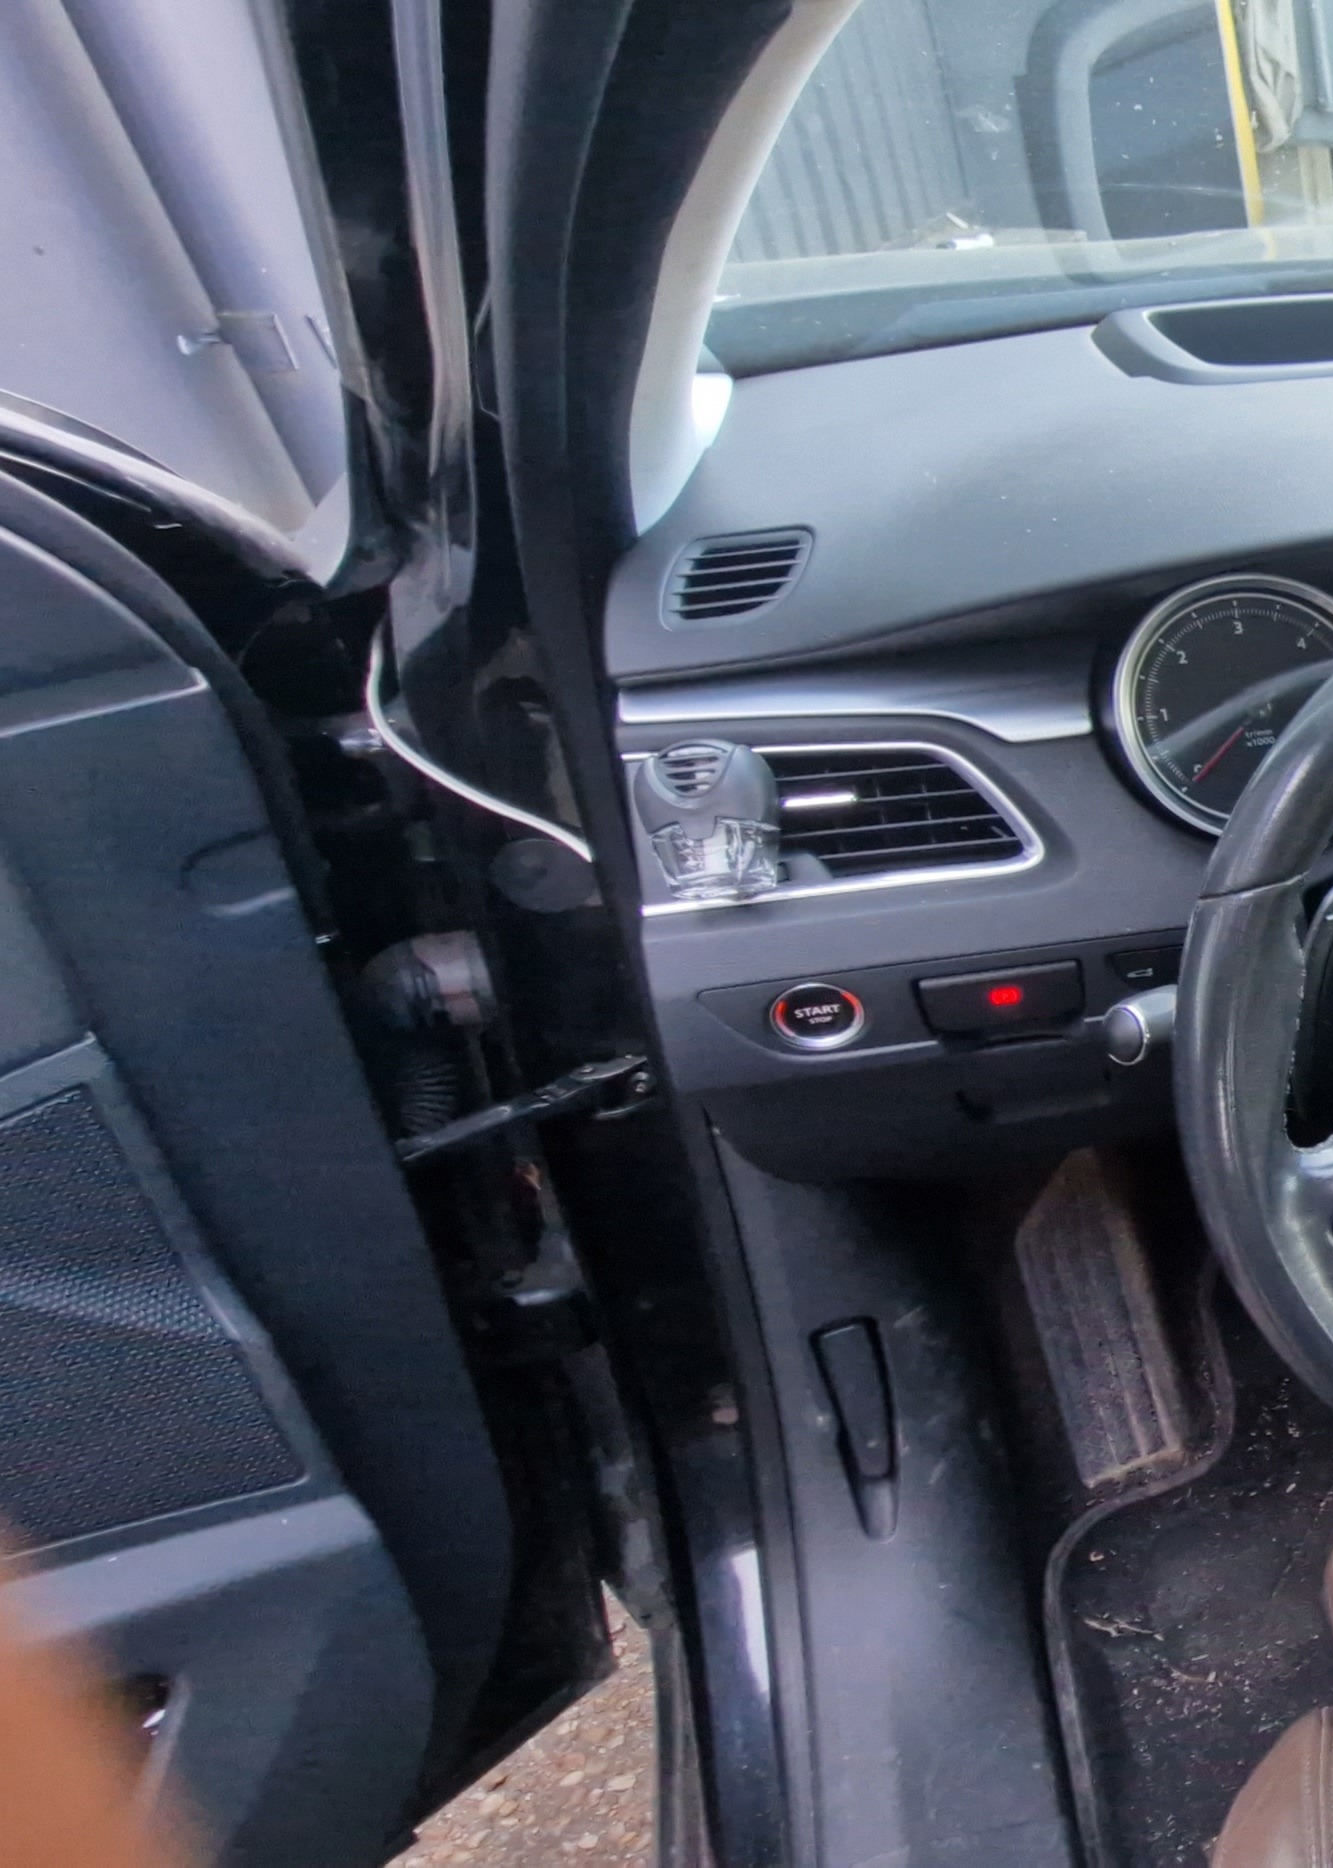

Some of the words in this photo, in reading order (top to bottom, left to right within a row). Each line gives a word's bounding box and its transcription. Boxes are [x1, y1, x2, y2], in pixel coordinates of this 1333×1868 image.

[1233, 621, 1243, 635] 3
[1296, 637, 1307, 650] 4
[1176, 651, 1188, 665] 2
[1159, 708, 1169, 722] 1
[794, 1003, 841, 1019] START
[808, 1015, 833, 1025] STOP
